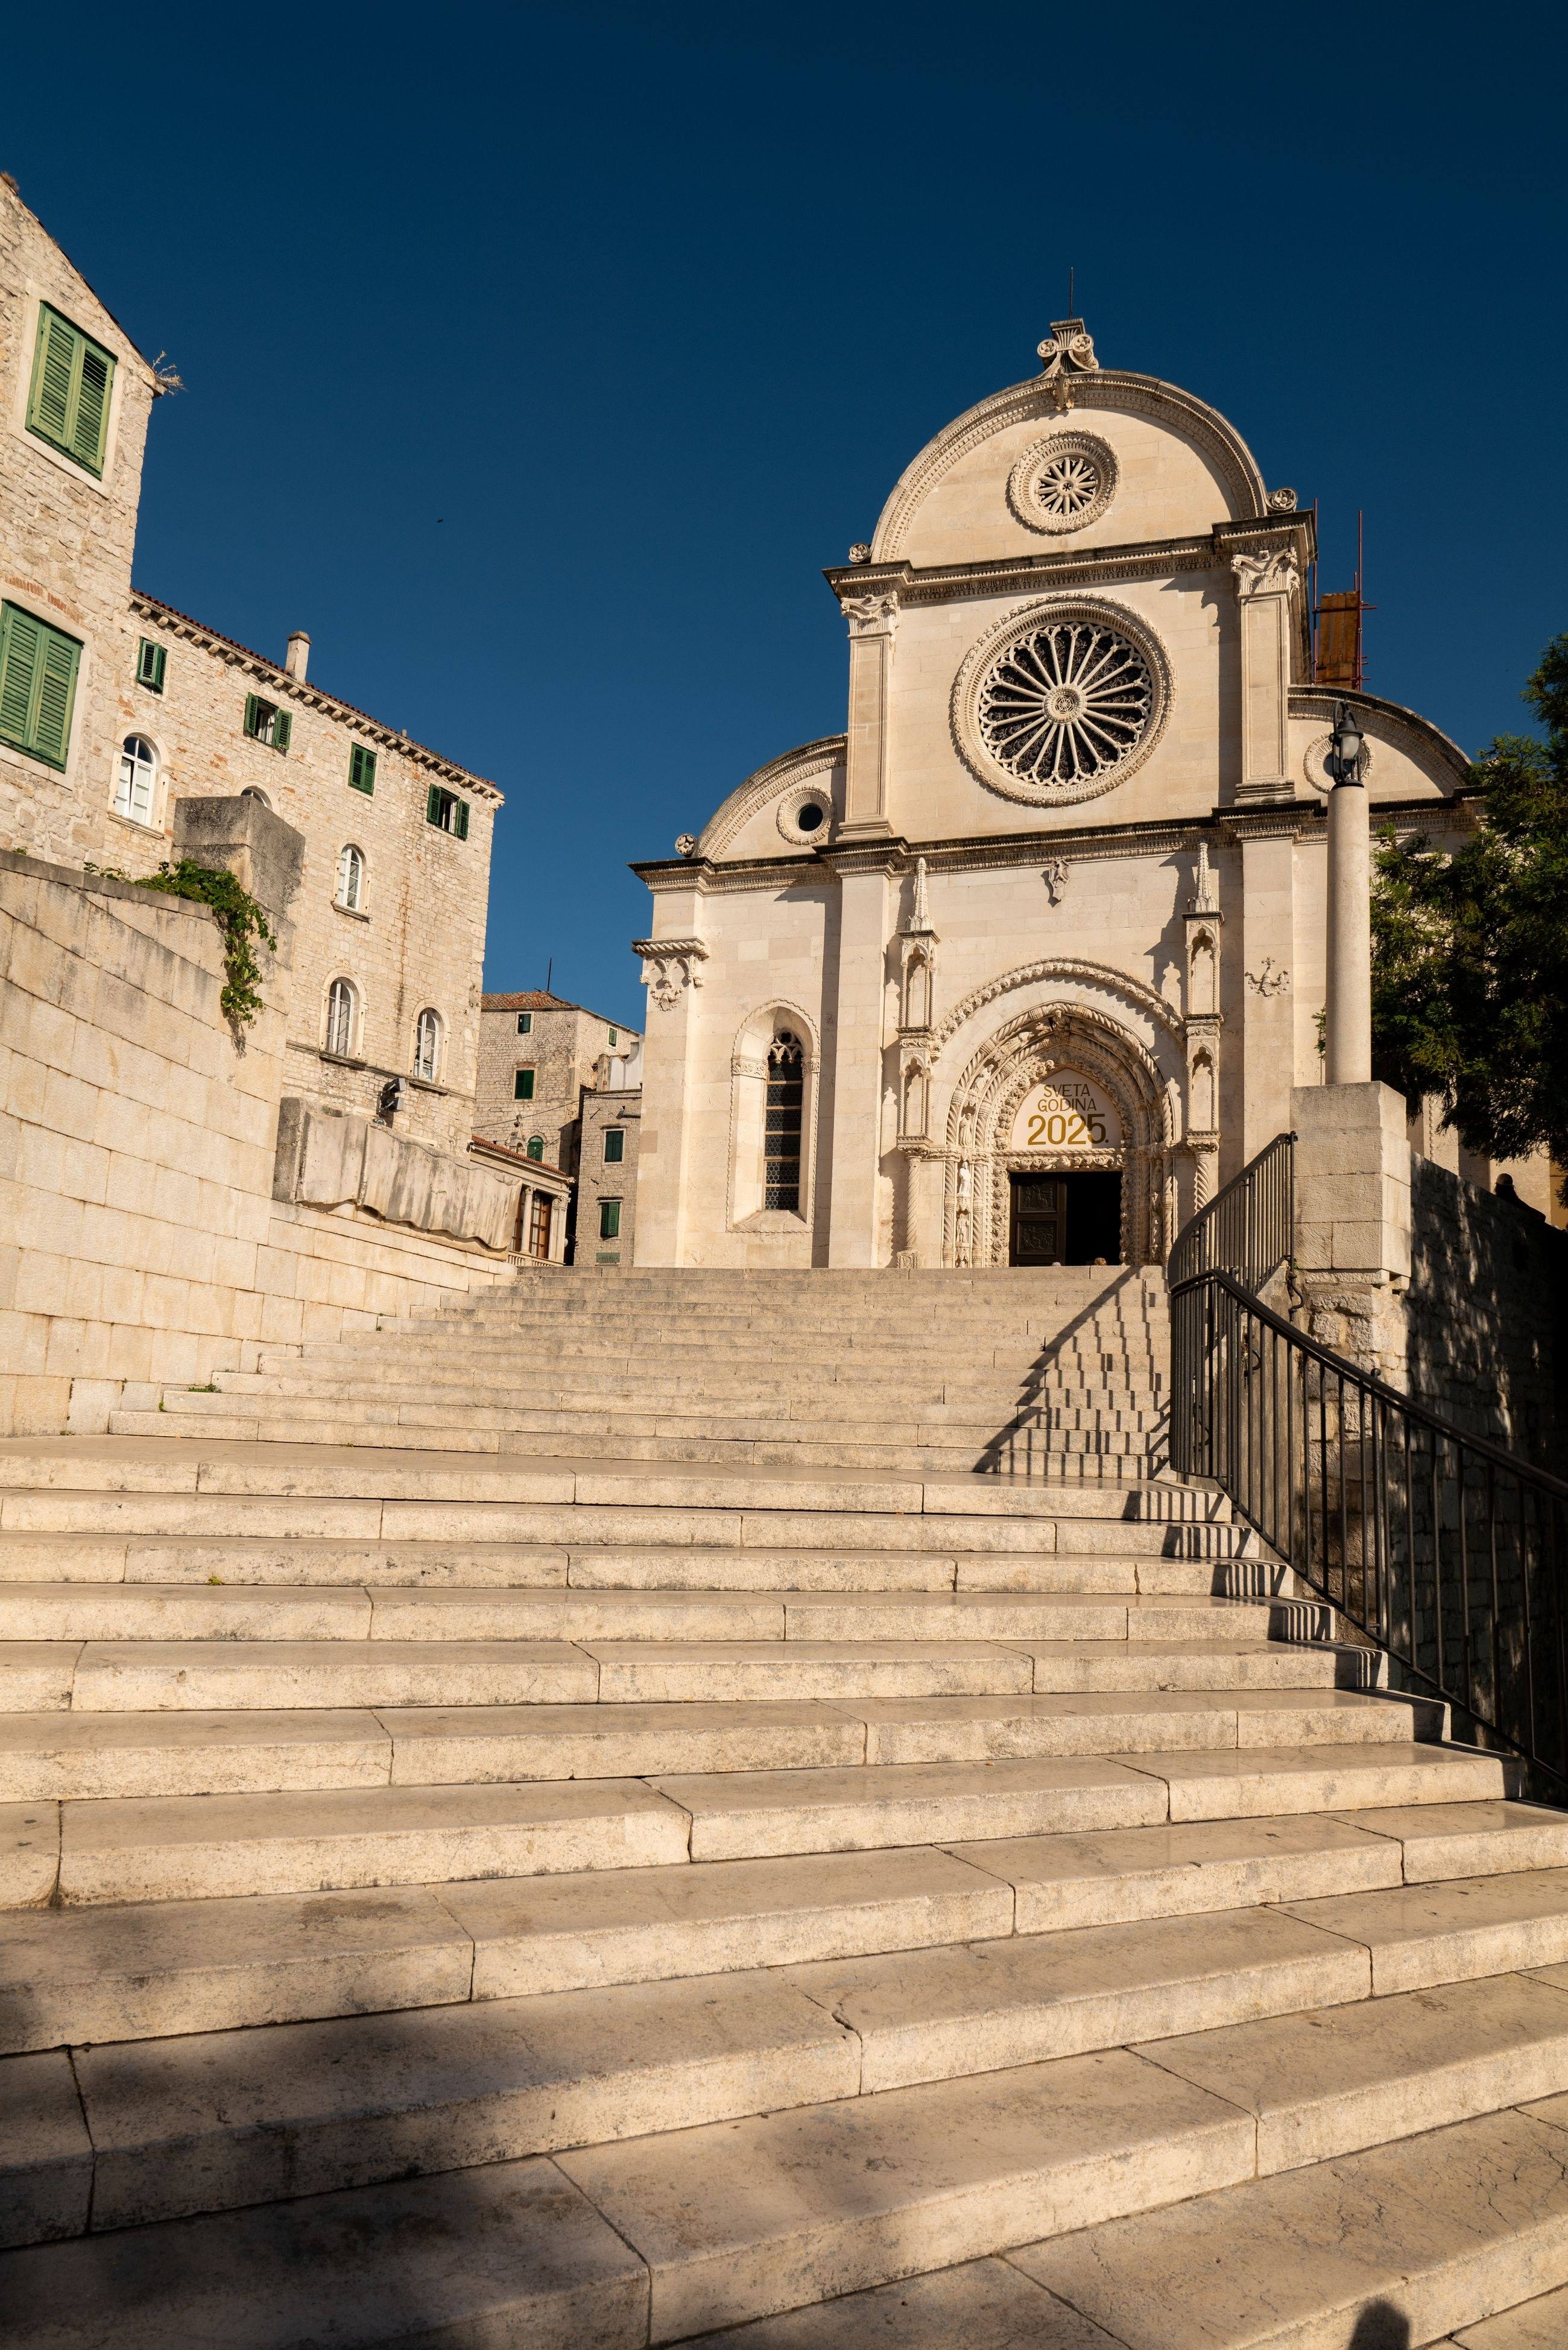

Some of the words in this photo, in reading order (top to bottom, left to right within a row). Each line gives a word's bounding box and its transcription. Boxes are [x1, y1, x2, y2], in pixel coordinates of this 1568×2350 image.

[1043, 1084, 1090, 1097] SVETA
[1037, 1098, 1097, 1112] GODINA
[1028, 1113, 1109, 1145] 2025.
